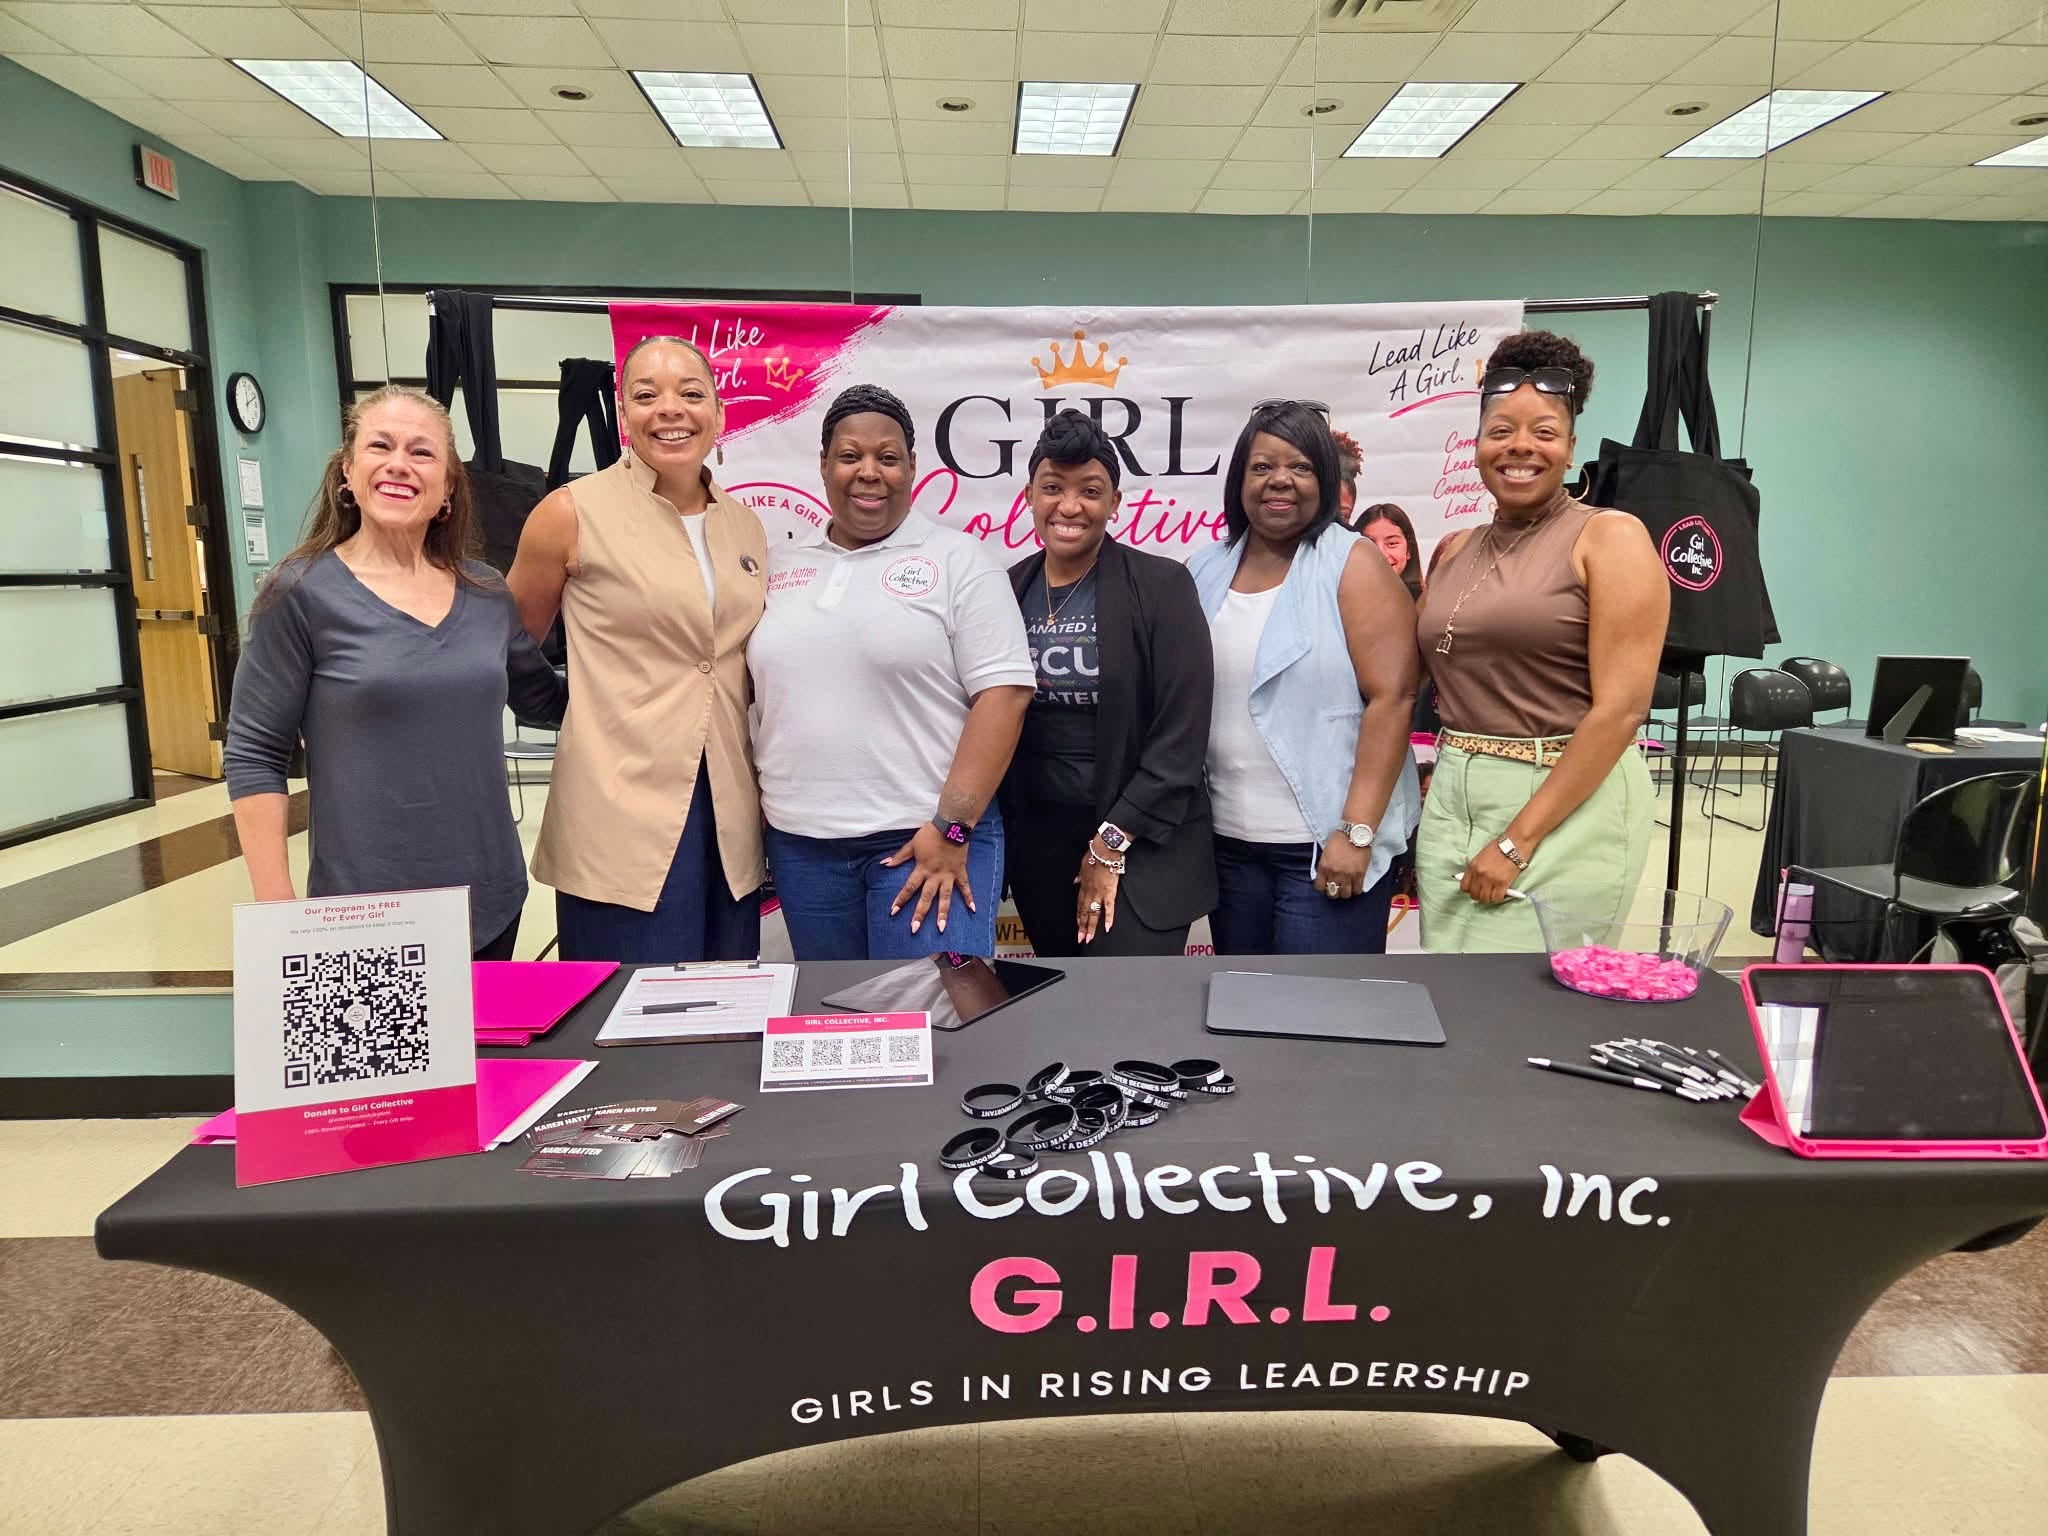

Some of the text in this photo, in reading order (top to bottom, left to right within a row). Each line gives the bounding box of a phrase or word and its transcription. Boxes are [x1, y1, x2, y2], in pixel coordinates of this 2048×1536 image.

[709, 317, 765, 359] Like
[1368, 320, 1481, 376] Lead Like
[714, 357, 747, 391] irl.
[1390, 357, 1464, 401] A Girl.
[1445, 431, 1479, 454] Com
[1443, 455, 1478, 476] Lear
[1433, 477, 1489, 500] Connec
[742, 495, 824, 528] LIKE A GIRL
[1445, 499, 1482, 519] Lead.
[790, 567, 818, 580] Hatten
[903, 565, 921, 576] Girl
[1026, 622, 1087, 634] ANATED
[304, 907, 322, 916] Our
[325, 905, 365, 914] Program
[379, 901, 401, 909] FREE
[340, 913, 365, 922] Every
[368, 911, 385, 919] Girl
[995, 923, 1027, 942] WH
[824, 1017, 872, 1025] COLLECTIVE,
[1128, 1080, 1160, 1092] BECOMES
[303, 1109, 337, 1118] Donate
[339, 1106, 350, 1114] to
[351, 1103, 368, 1112] Girl
[370, 1098, 414, 1110] Collective
[595, 1107, 623, 1115] KAREN
[624, 1106, 657, 1114] HATTEN
[981, 1103, 1012, 1117] IMPORTANT
[534, 1113, 592, 1132] KAREN HATT
[1125, 1119, 1139, 1127] THE
[540, 1146, 603, 1156] KAREN HATTEN
[704, 1150, 1671, 1248] Girl Collective, Inc.
[969, 1246, 1389, 1334] G.I.R.L.
[791, 1361, 1531, 1425] GIRLS IN RISING LEADERSHIP
